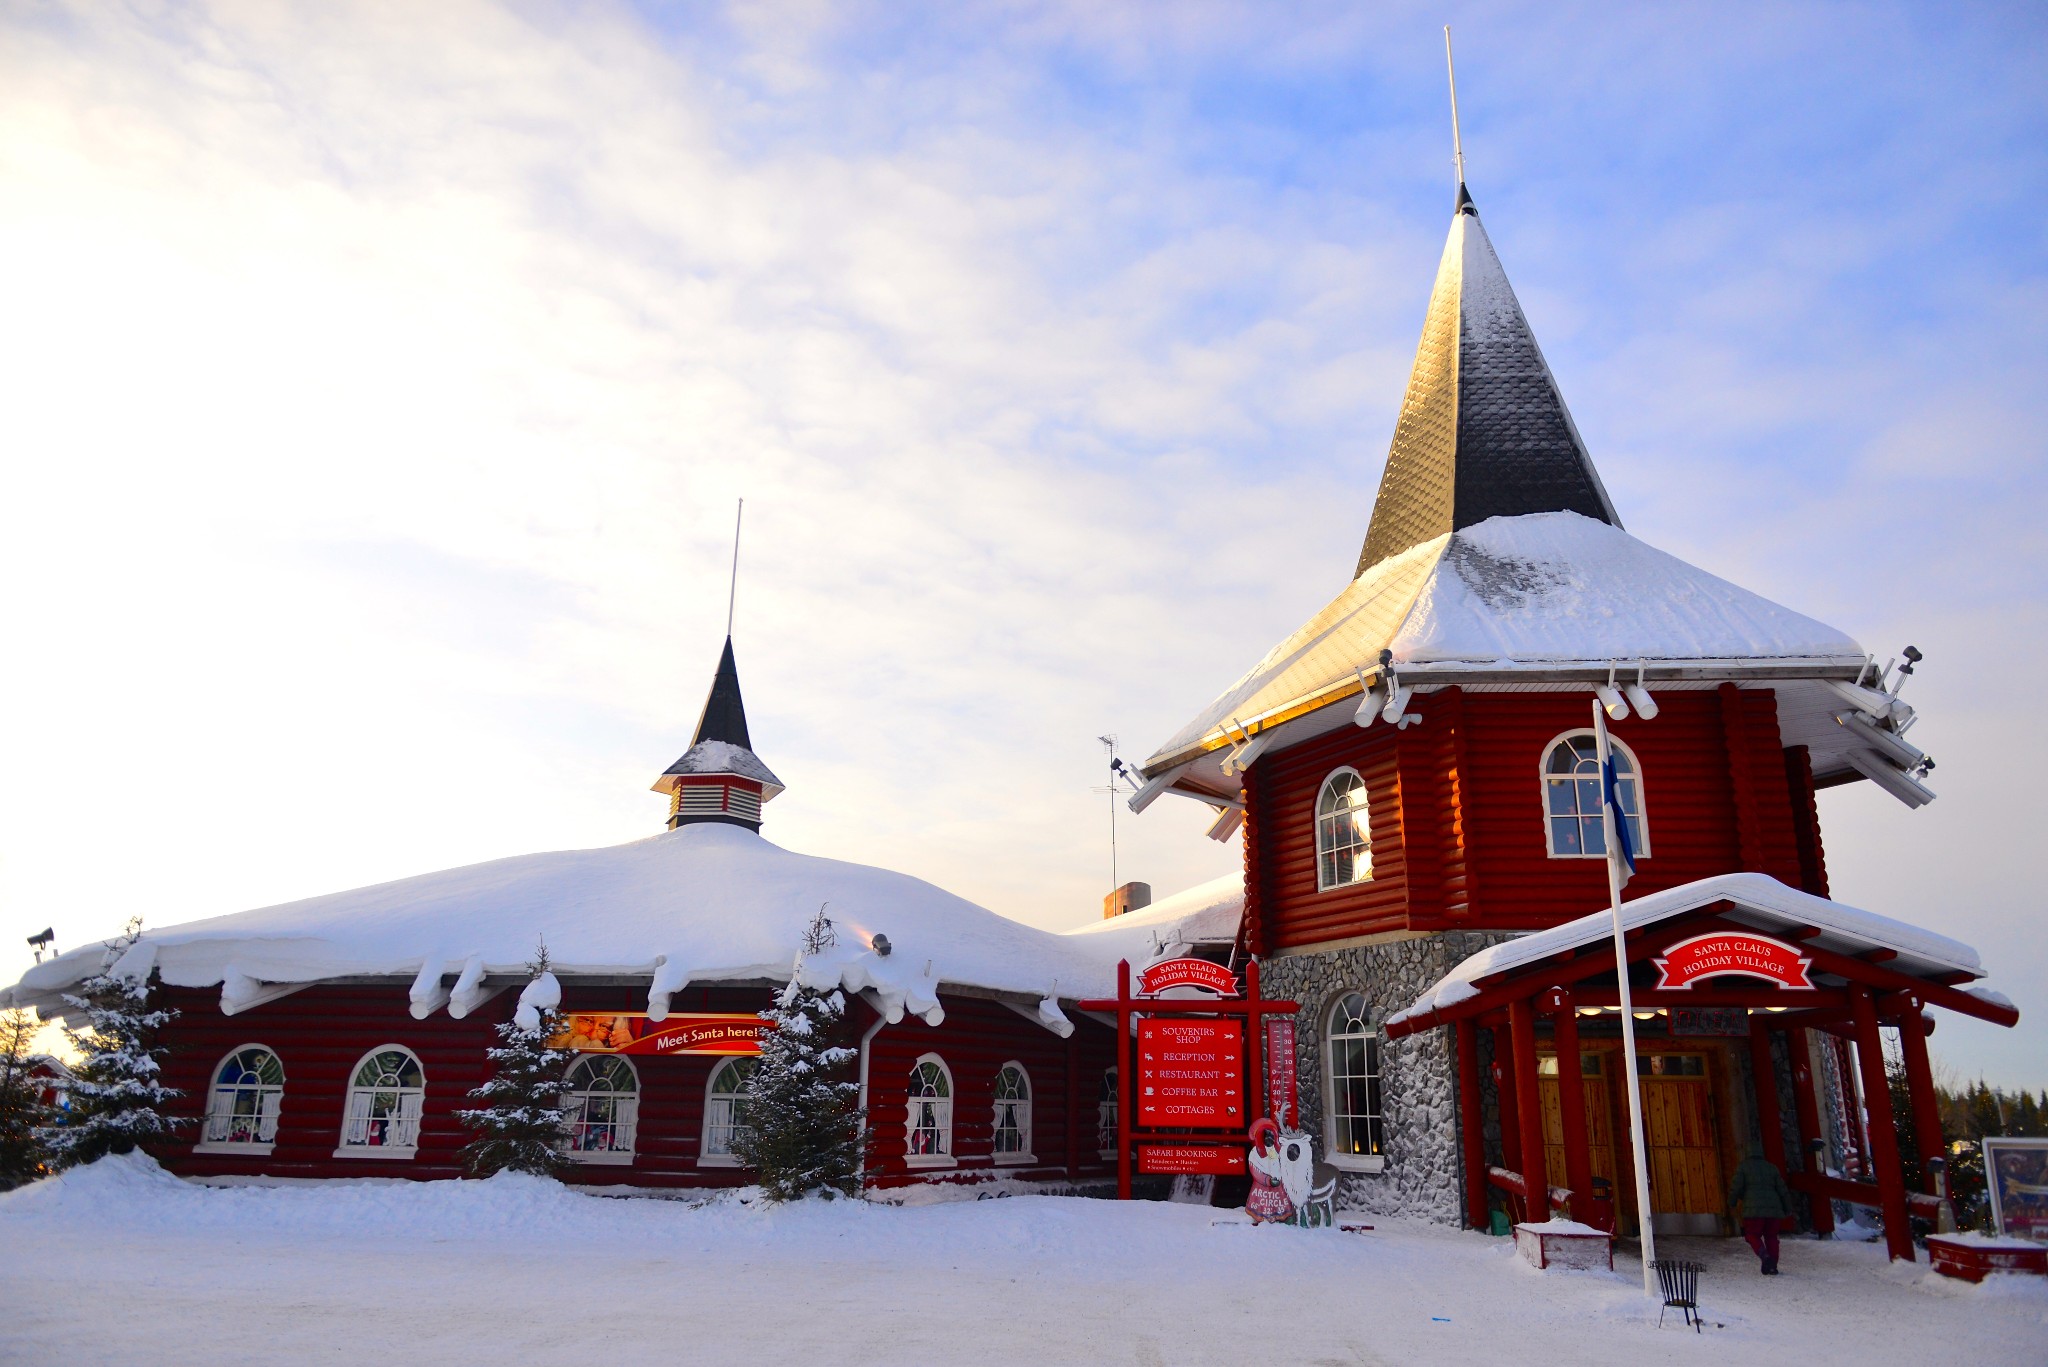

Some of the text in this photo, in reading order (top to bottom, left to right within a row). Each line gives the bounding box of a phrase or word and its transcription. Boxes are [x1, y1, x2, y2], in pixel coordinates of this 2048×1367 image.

[1694, 942, 1772, 957] SANTA CLAUS
[1160, 963, 1217, 974] SANTA CLAUS
[1683, 955, 1785, 975] HOLIDAY VILLAGE
[1151, 971, 1226, 987] HOLIDAY VILLAGE
[1162, 1027, 1215, 1036] SOUVENIRS
[657, 1026, 758, 1050] Meet Santa here!
[1176, 1035, 1201, 1044] SHOP
[1163, 1052, 1215, 1061] RECEPTION
[1159, 1070, 1220, 1079] RESTAURANT
[1161, 1087, 1218, 1097] COFFEE BAR
[1165, 1105, 1215, 1115] COTTAGES
[1146, 1149, 1217, 1158] SAFARI BOOKINGS
[1251, 1187, 1281, 1200] ARCTIC
[1259, 1198, 1289, 1208] CIRCLE
